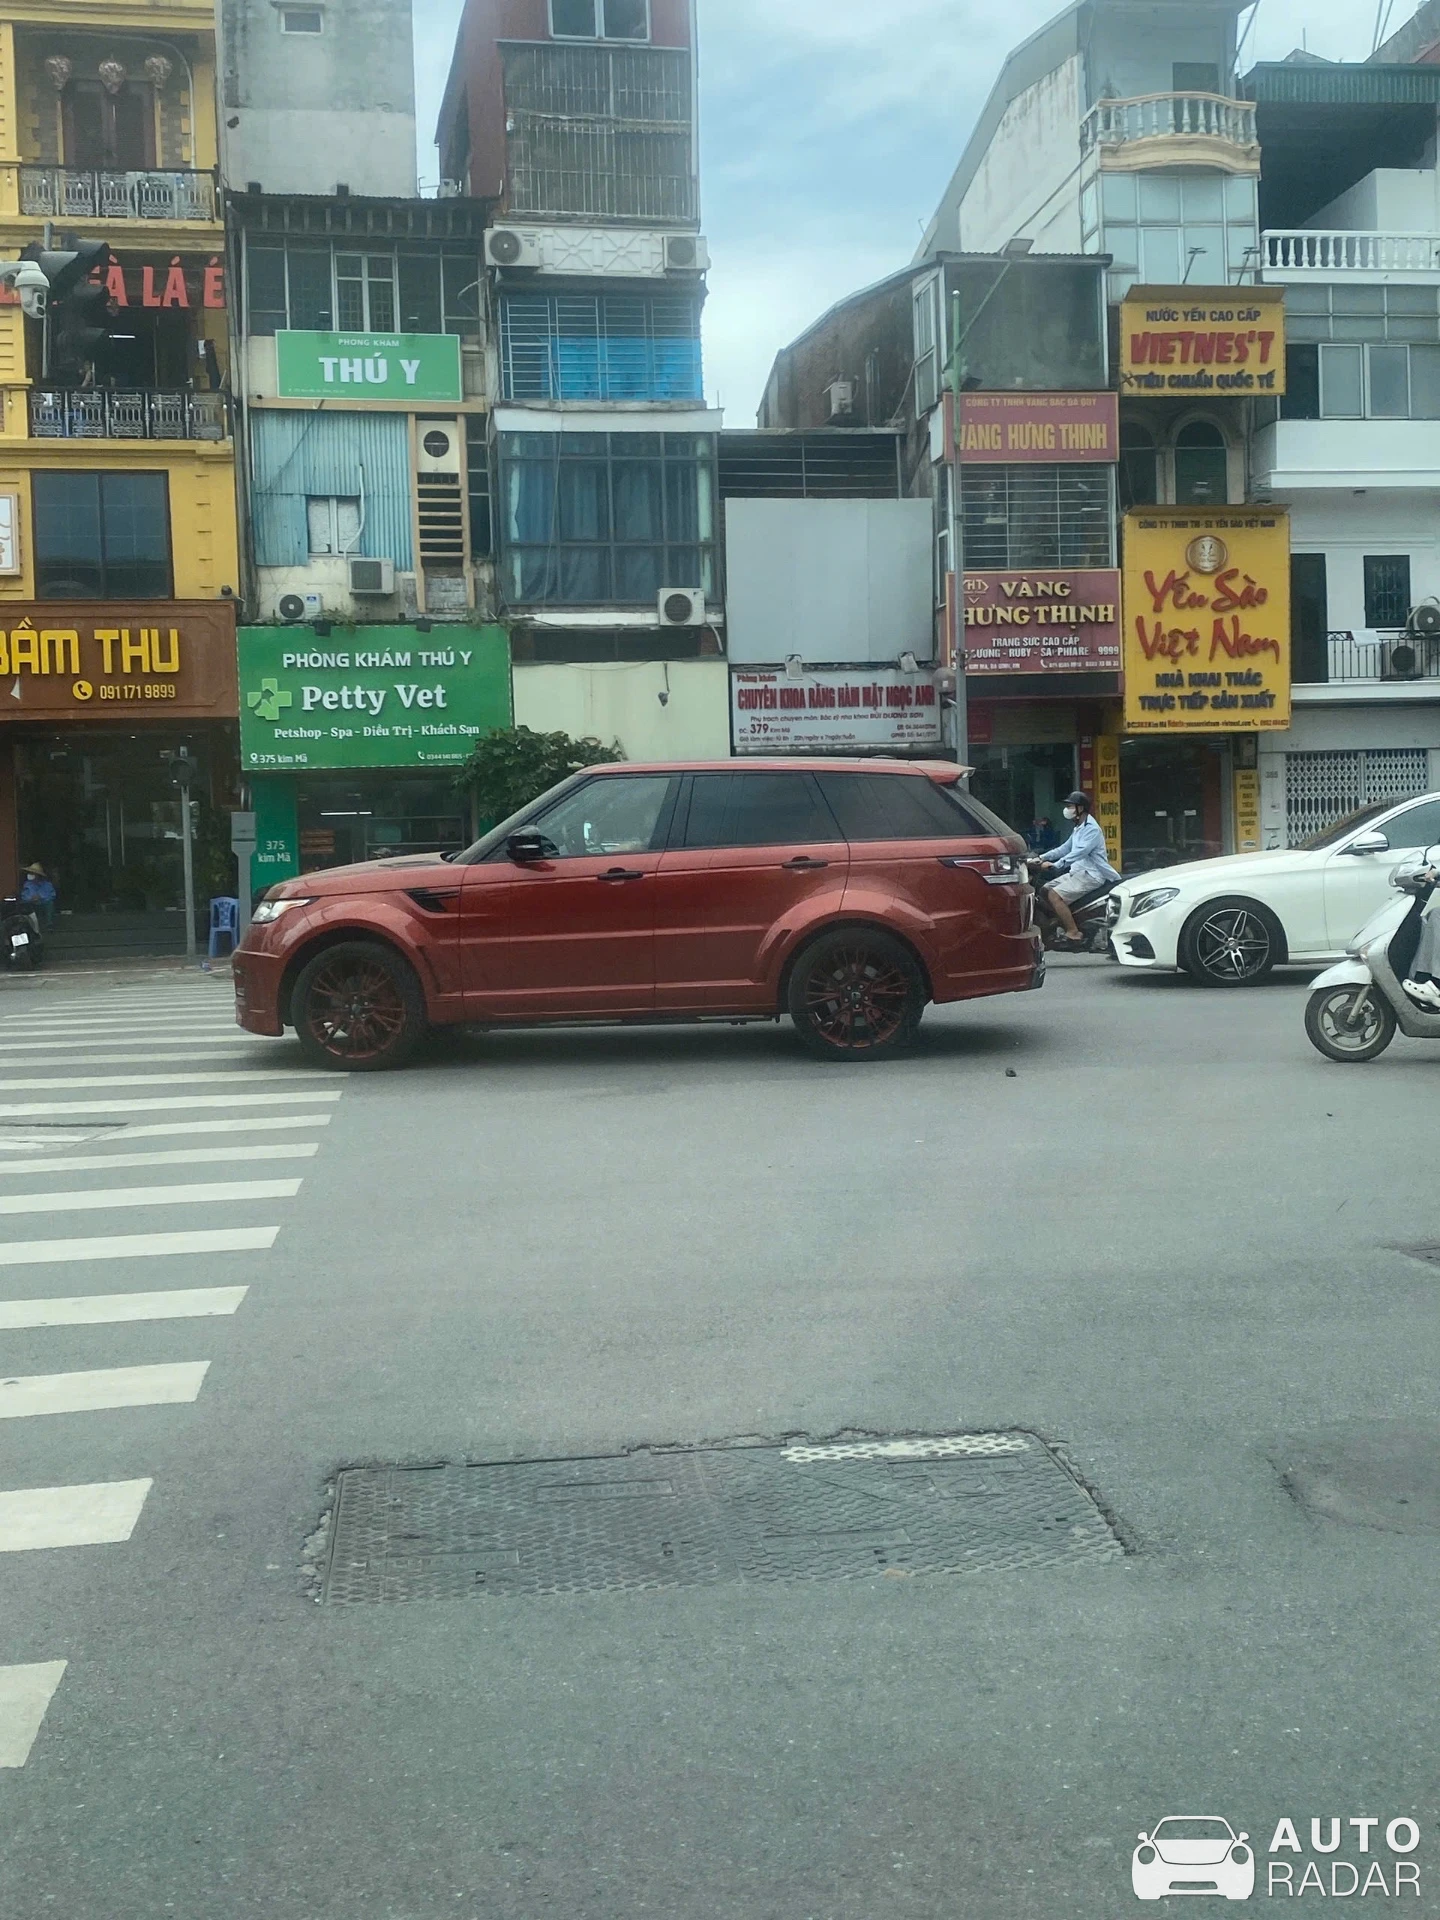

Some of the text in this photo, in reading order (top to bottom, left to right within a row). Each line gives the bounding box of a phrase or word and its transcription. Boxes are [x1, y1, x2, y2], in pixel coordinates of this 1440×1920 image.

[143, 255, 190, 308] LÁ
[204, 256, 225, 308] É
[1146, 307, 1261, 321] NƯỚC YẾN CAO CẤP
[318, 352, 421, 385] THÚ Y
[1216, 369, 1254, 389] QUỐC
[1257, 369, 1276, 389] TẾ
[991, 398, 1000, 407] TY
[1008, 421, 1055, 450] HƯNG
[1059, 423, 1107, 455] THỊNH
[1000, 577, 1072, 597] VÀNG
[1143, 567, 1268, 613] Yến Sào
[1034, 604, 1115, 629] THỊNH
[992, 637, 1021, 647] TRANG
[1043, 636, 1060, 646] CAO
[1135, 614, 1280, 665] Việt Nam
[94, 628, 180, 674] THU
[283, 646, 473, 668] PHÒNG KHÁM THÚ Y
[1009, 648, 1032, 657] RUBY
[1098, 645, 1119, 656] 9999
[1155, 668, 1263, 688] NHÀ KHAI THÁC
[100, 684, 176, 699] 091 171 9899
[301, 684, 448, 715] Petty Vet
[738, 682, 936, 711] CHUYÊN KHOA RĂNG HÀM MẶT NGỌC ANH
[1139, 689, 1276, 713] TRỰC TIẾP SẢN XUẤT
[274, 727, 321, 740] Petshop
[330, 727, 352, 740] Spa
[363, 724, 390, 736] Điều
[393, 725, 412, 738] Trị
[422, 723, 457, 735] Khách
[459, 725, 480, 737] Sạn
[750, 723, 769, 734] 379
[259, 754, 276, 763] 375
[277, 753, 294, 763] kim
[266, 840, 285, 850] 375
[257, 851, 291, 862] kim Mã
